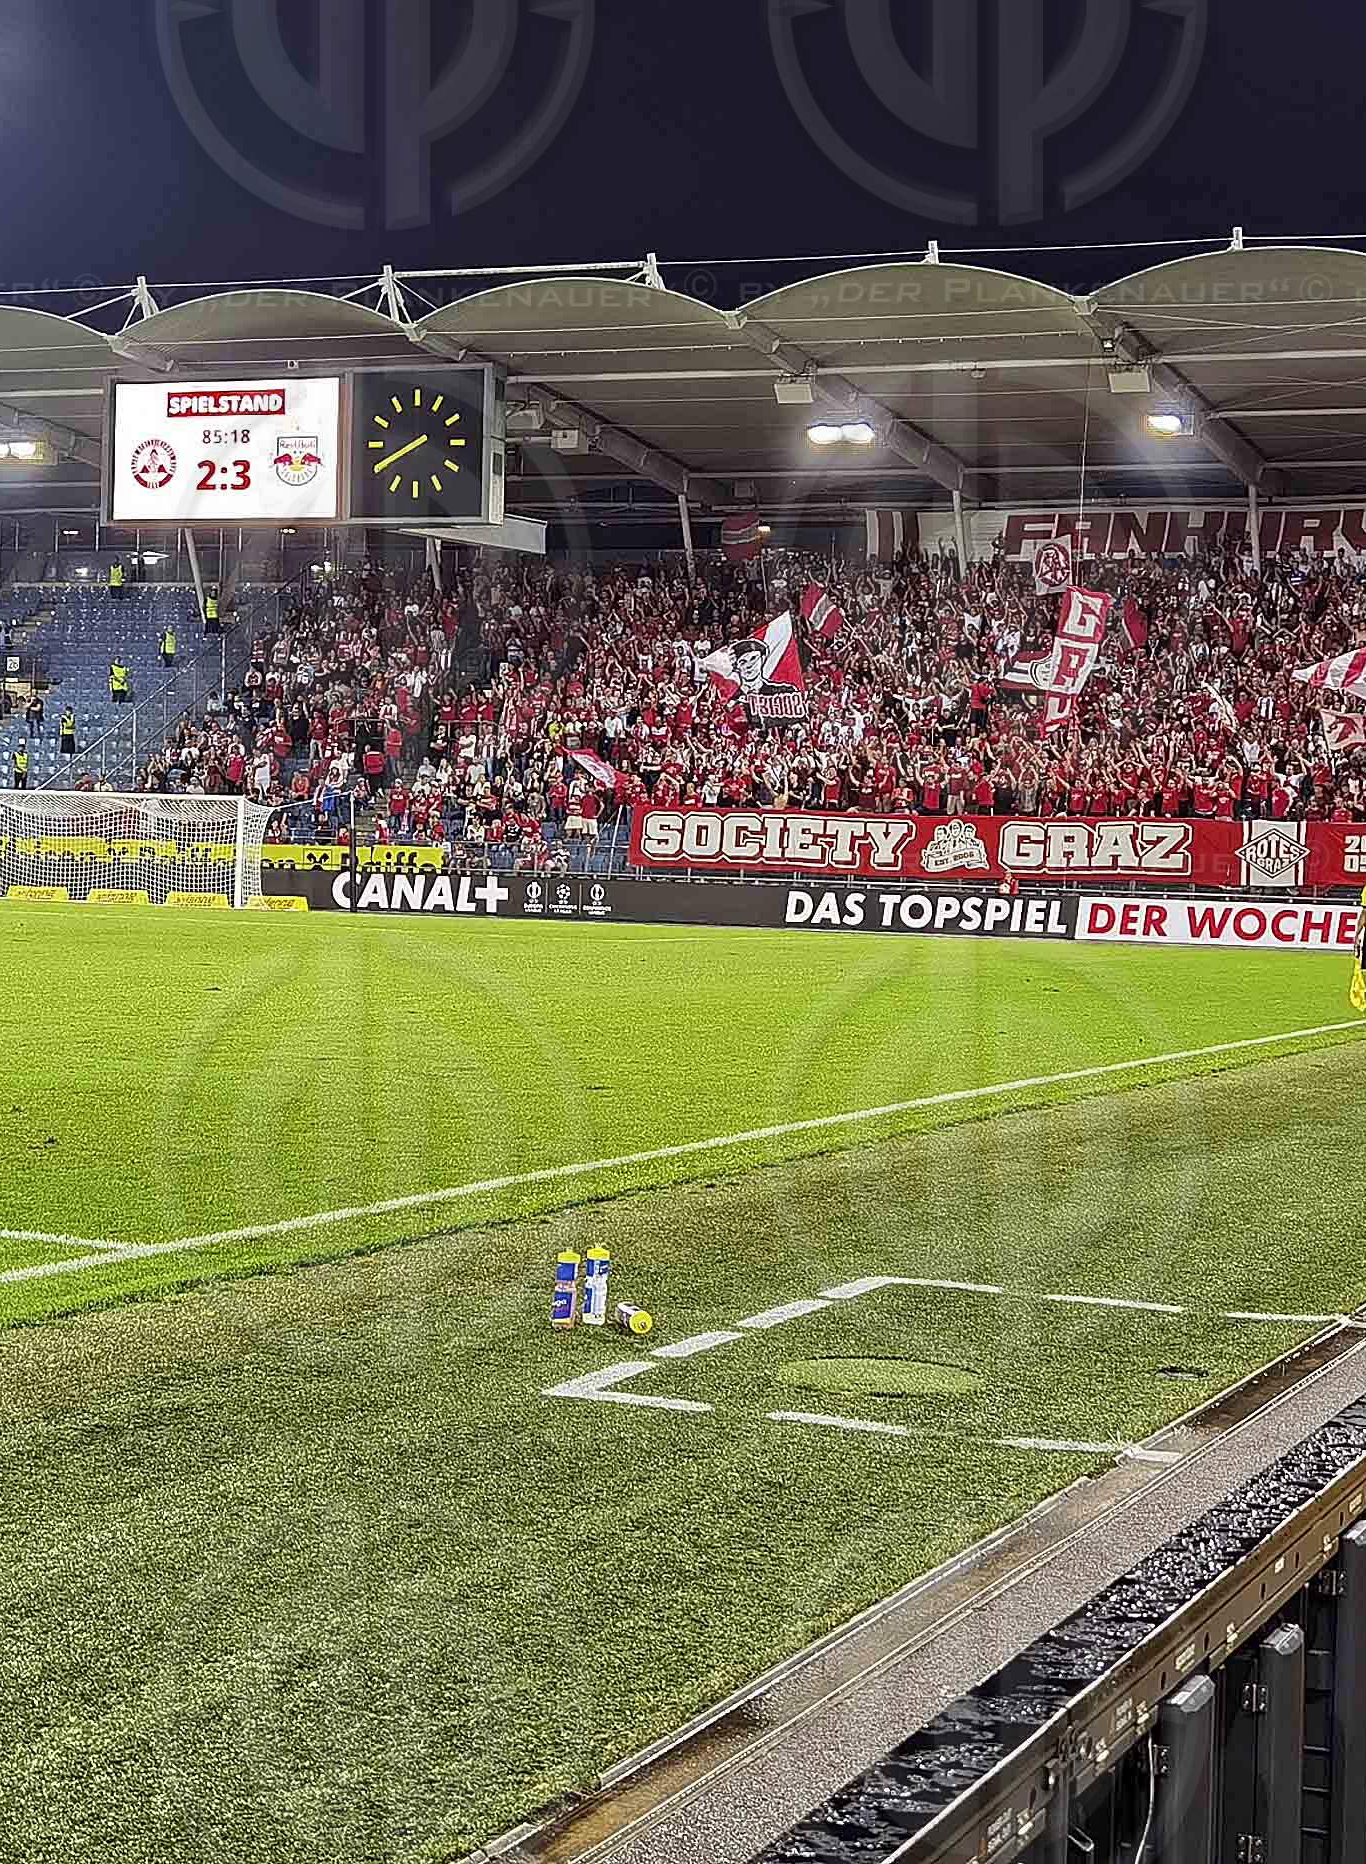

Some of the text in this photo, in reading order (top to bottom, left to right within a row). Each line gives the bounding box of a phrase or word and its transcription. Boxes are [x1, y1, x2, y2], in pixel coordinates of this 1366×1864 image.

[169, 393, 282, 414] SPIELSTAND
[202, 429, 250, 444] 85:18
[196, 460, 251, 490] 2:3
[641, 811, 1192, 876] SOCIETY GRAZ
[1246, 833, 1300, 861] ROTES
[1257, 858, 1290, 872] GRAZ
[333, 871, 509, 913] CANAL+
[785, 891, 1358, 945] DAS TOPSPIEL DER WOCHE
